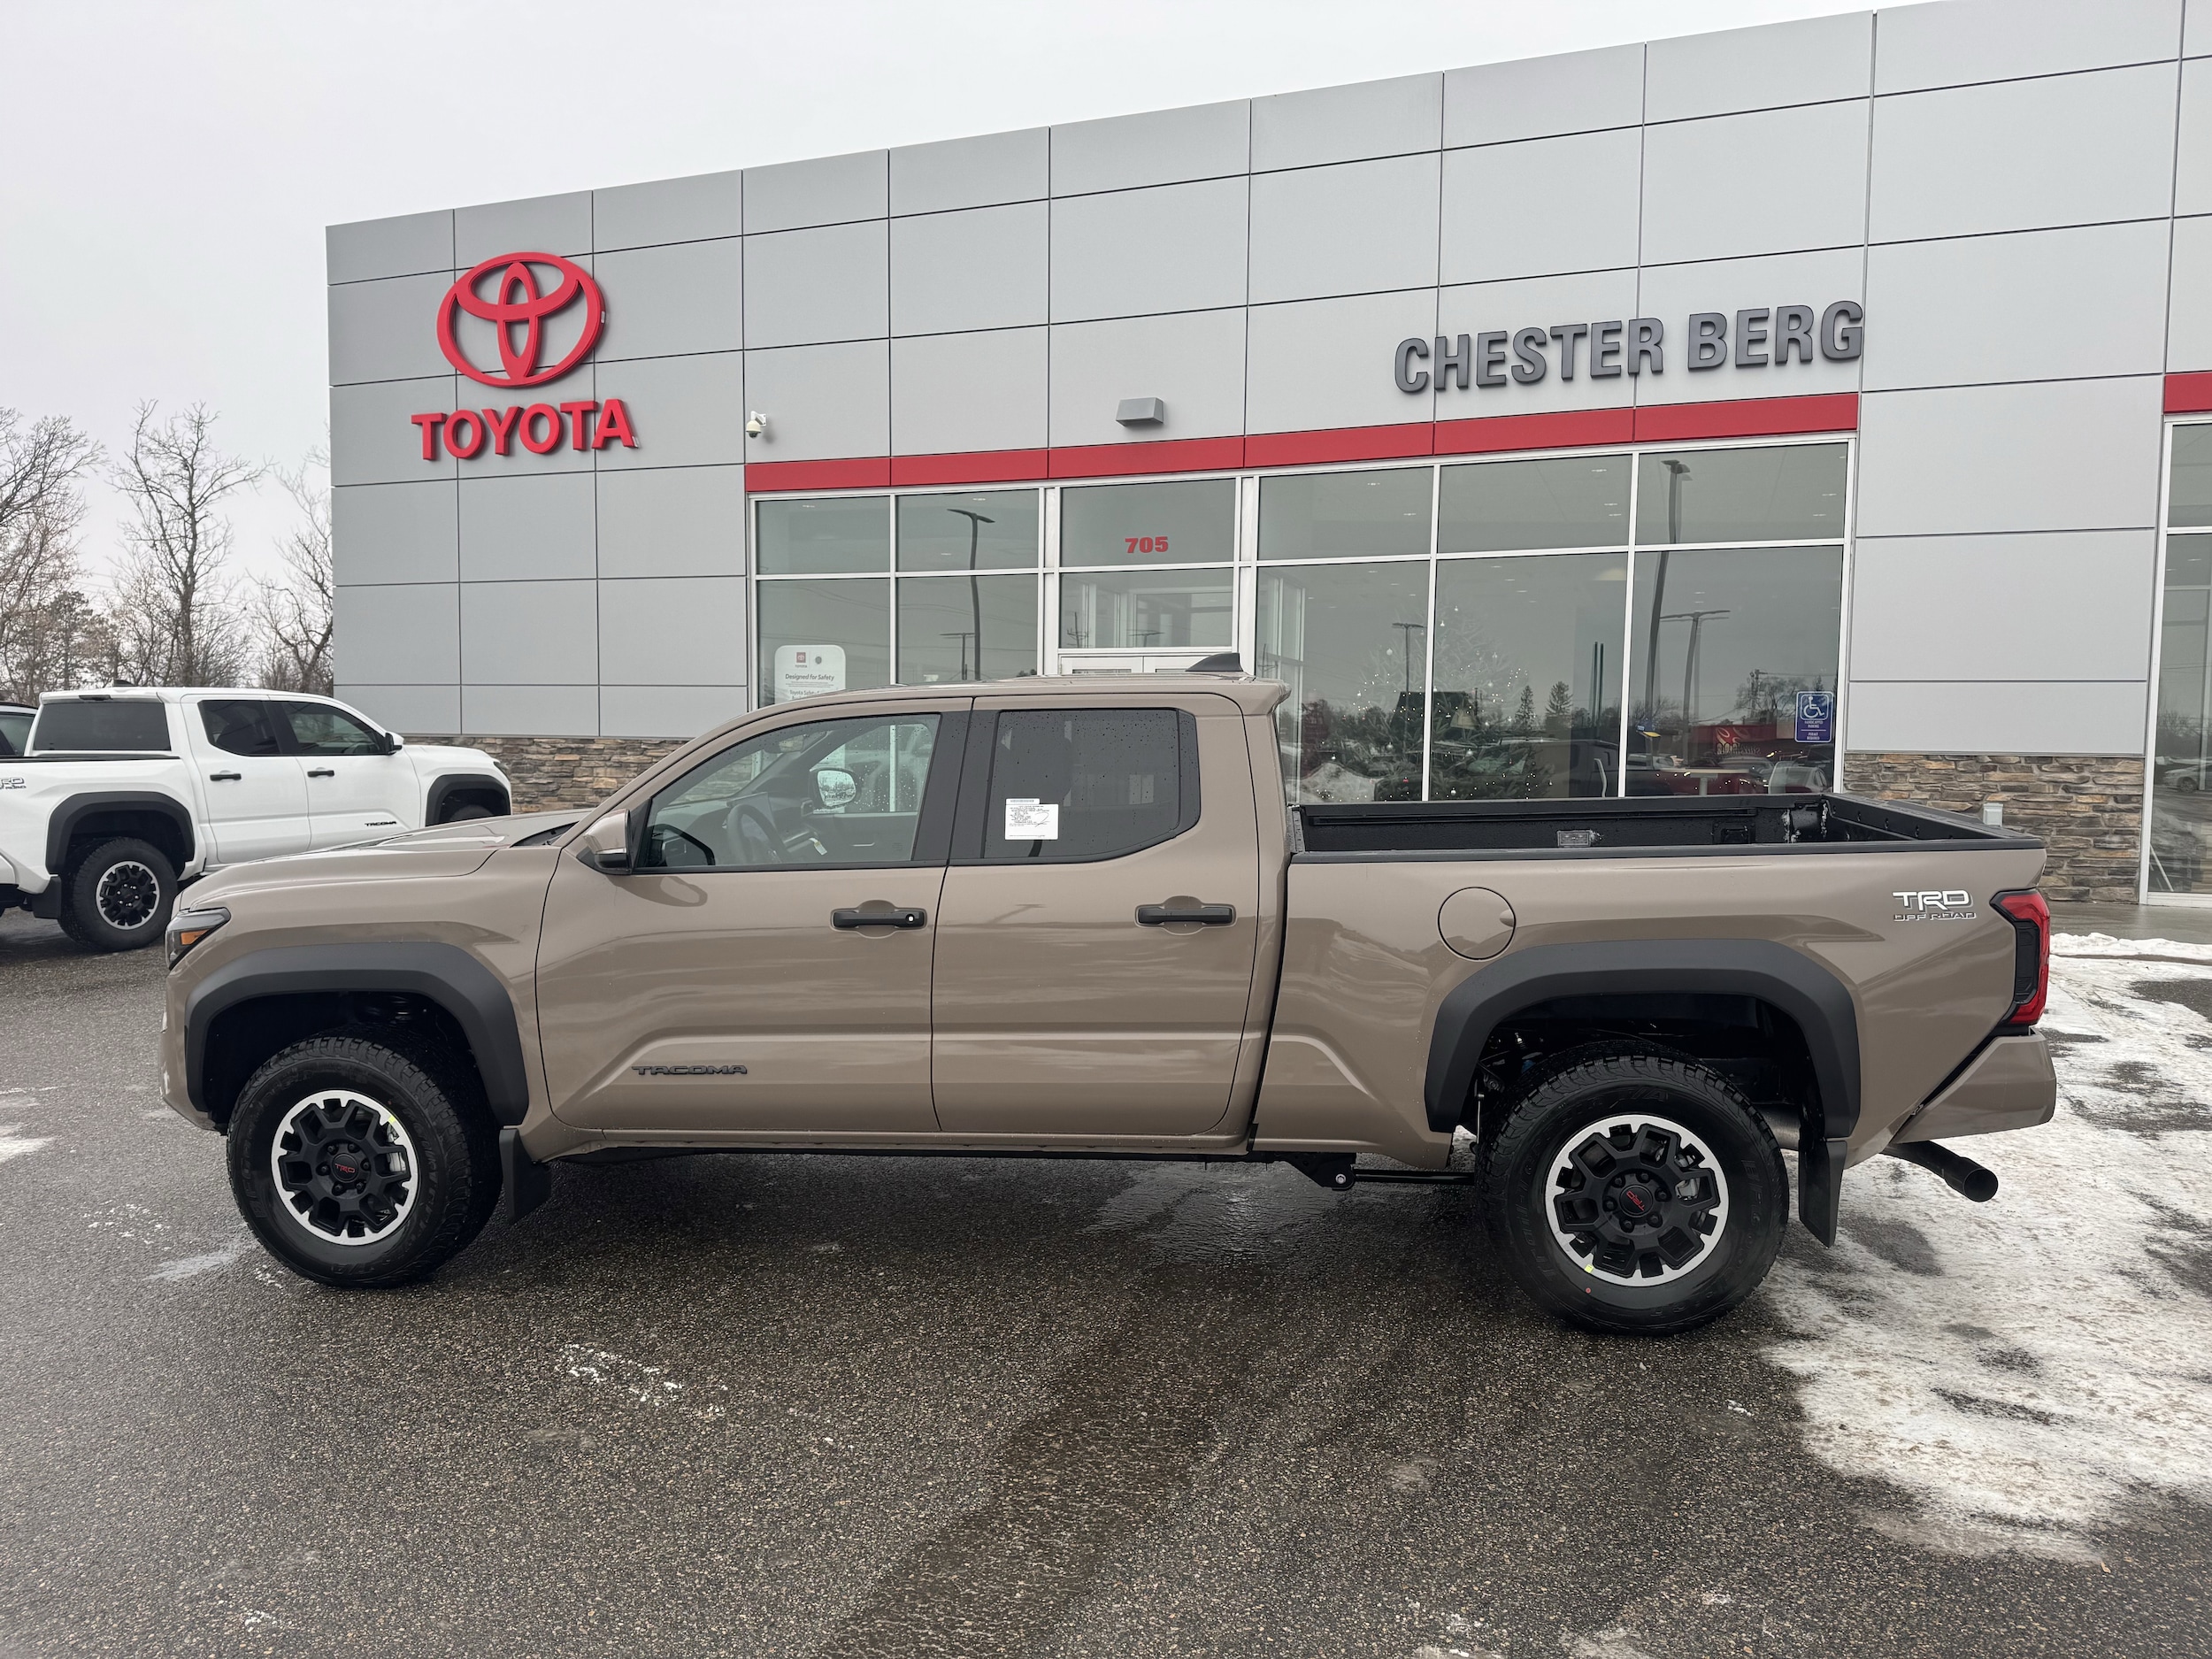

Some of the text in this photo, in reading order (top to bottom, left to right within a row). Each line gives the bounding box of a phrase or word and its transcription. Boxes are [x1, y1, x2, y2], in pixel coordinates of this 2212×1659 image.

[1394, 300, 1863, 395] CHESTER BERG
[411, 398, 639, 460] TOYOTA
[1125, 536, 1169, 553] 705
[0, 776, 25, 787] RD
[1892, 889, 1973, 912] TRD
[1893, 910, 1978, 922] OFF ROAD
[631, 1064, 748, 1075] TACOMA
[334, 1163, 356, 1174] TRD
[1625, 1190, 1645, 1211] TRD
